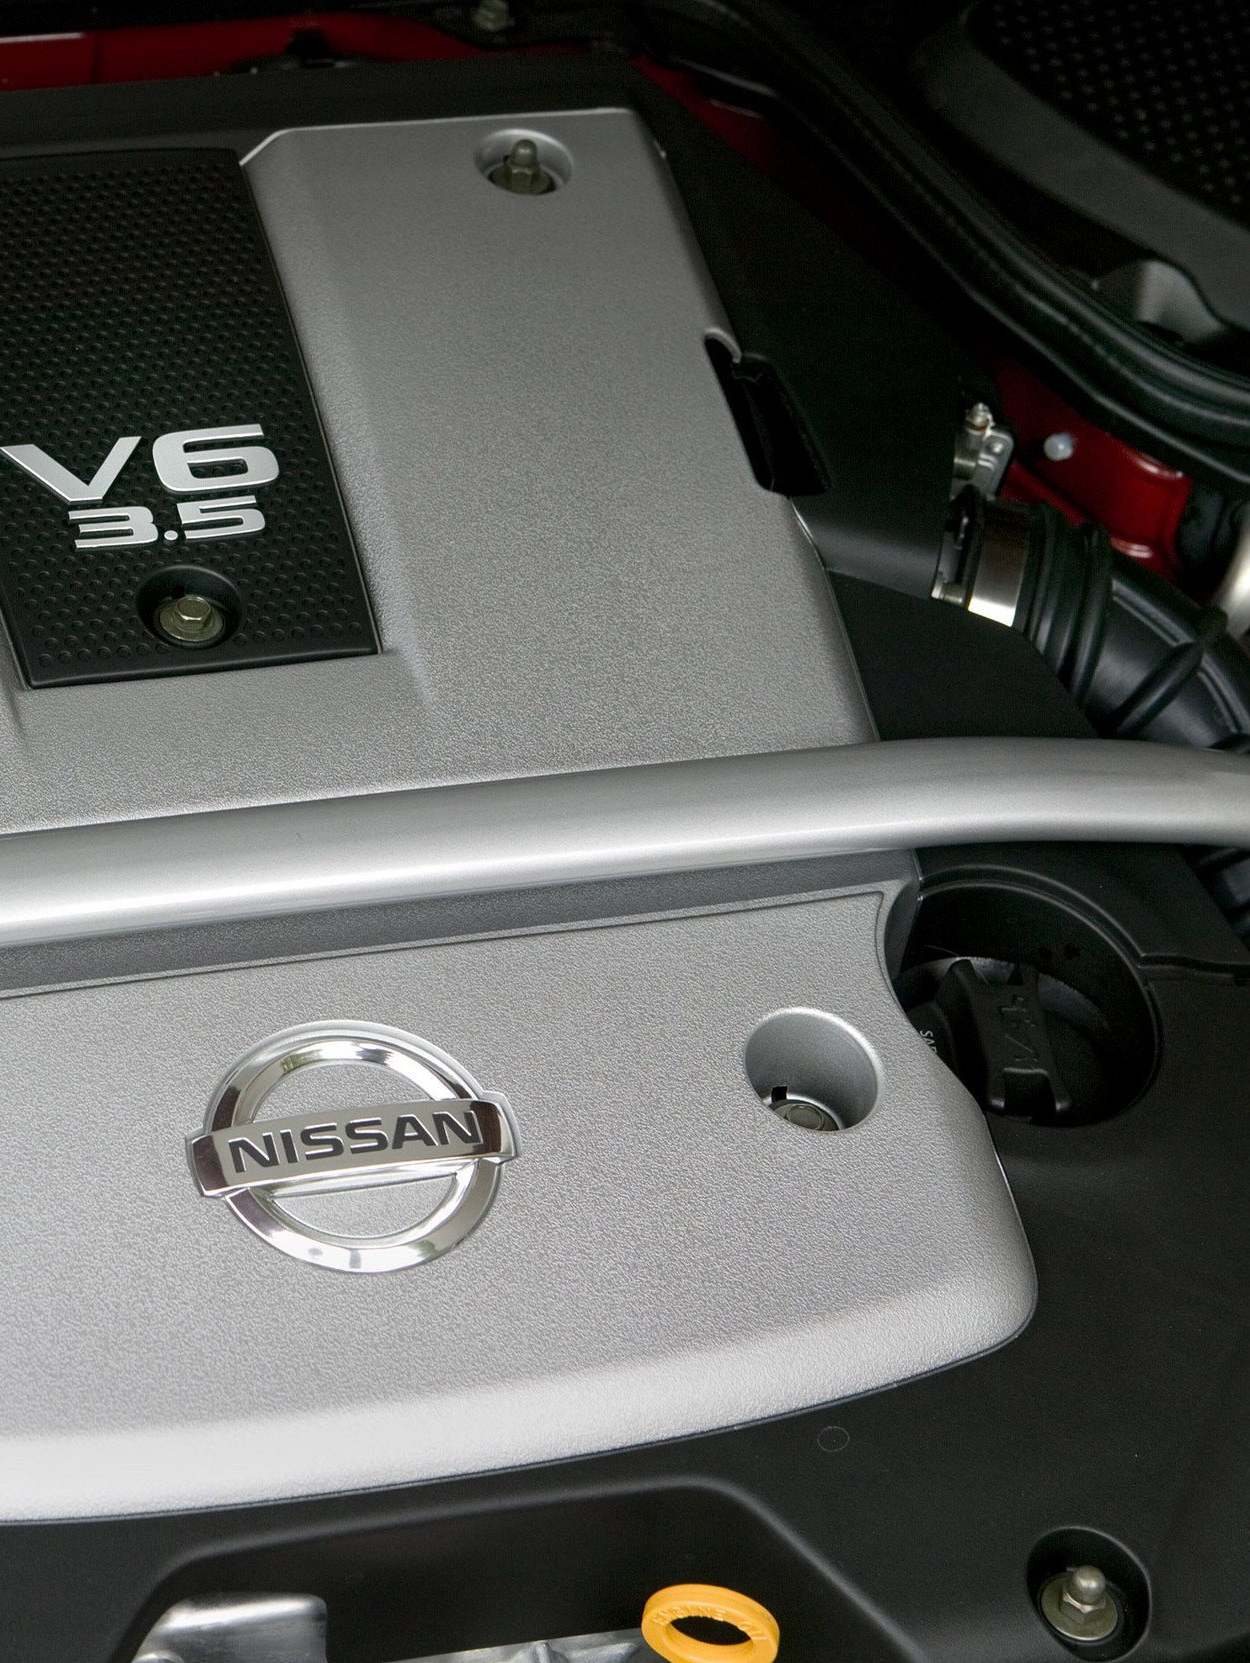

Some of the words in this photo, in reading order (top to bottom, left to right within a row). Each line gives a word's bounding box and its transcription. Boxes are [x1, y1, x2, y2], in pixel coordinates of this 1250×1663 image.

[0, 423, 280, 502] V6
[68, 495, 266, 549] 3.5
[227, 1110, 485, 1174] NISSAN
